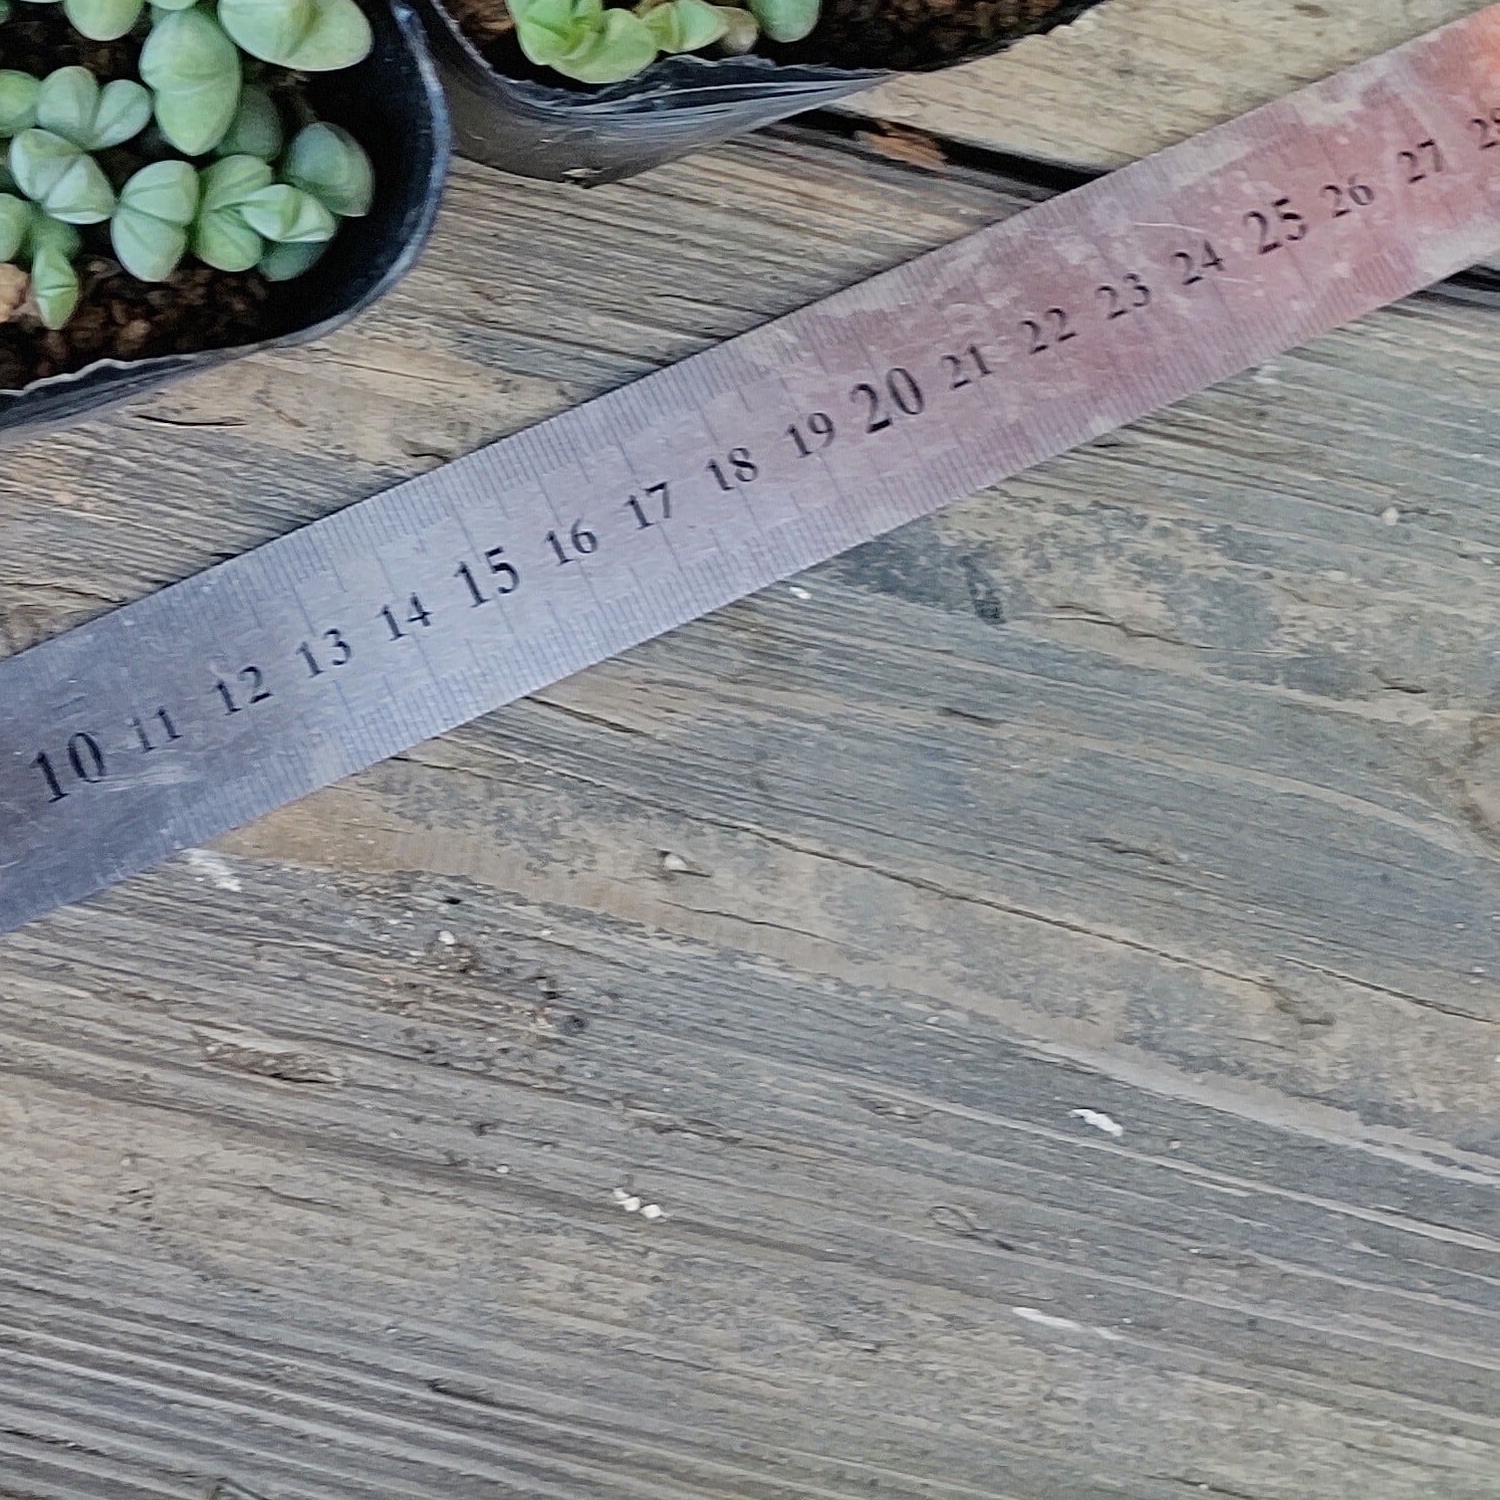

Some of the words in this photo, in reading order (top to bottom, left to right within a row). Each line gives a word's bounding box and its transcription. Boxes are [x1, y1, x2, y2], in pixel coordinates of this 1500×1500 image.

[30, 731, 108, 803] 10
[130, 706, 184, 755] 11
[212, 665, 272, 716] 12
[296, 628, 353, 678] 13
[375, 592, 433, 641] 14
[452, 546, 520, 608] 15
[543, 518, 598, 565] 16
[623, 481, 672, 530] 17
[704, 446, 758, 492] 18
[784, 410, 836, 459] 19
[848, 366, 925, 434] 20
[941, 344, 993, 390] 21
[1019, 307, 1077, 354] 22
[1095, 272, 1152, 319] 23
[1171, 240, 1225, 285] 24
[1242, 198, 1308, 254] 25
[1319, 172, 1376, 218] 26
[1397, 138, 1445, 184] 27
